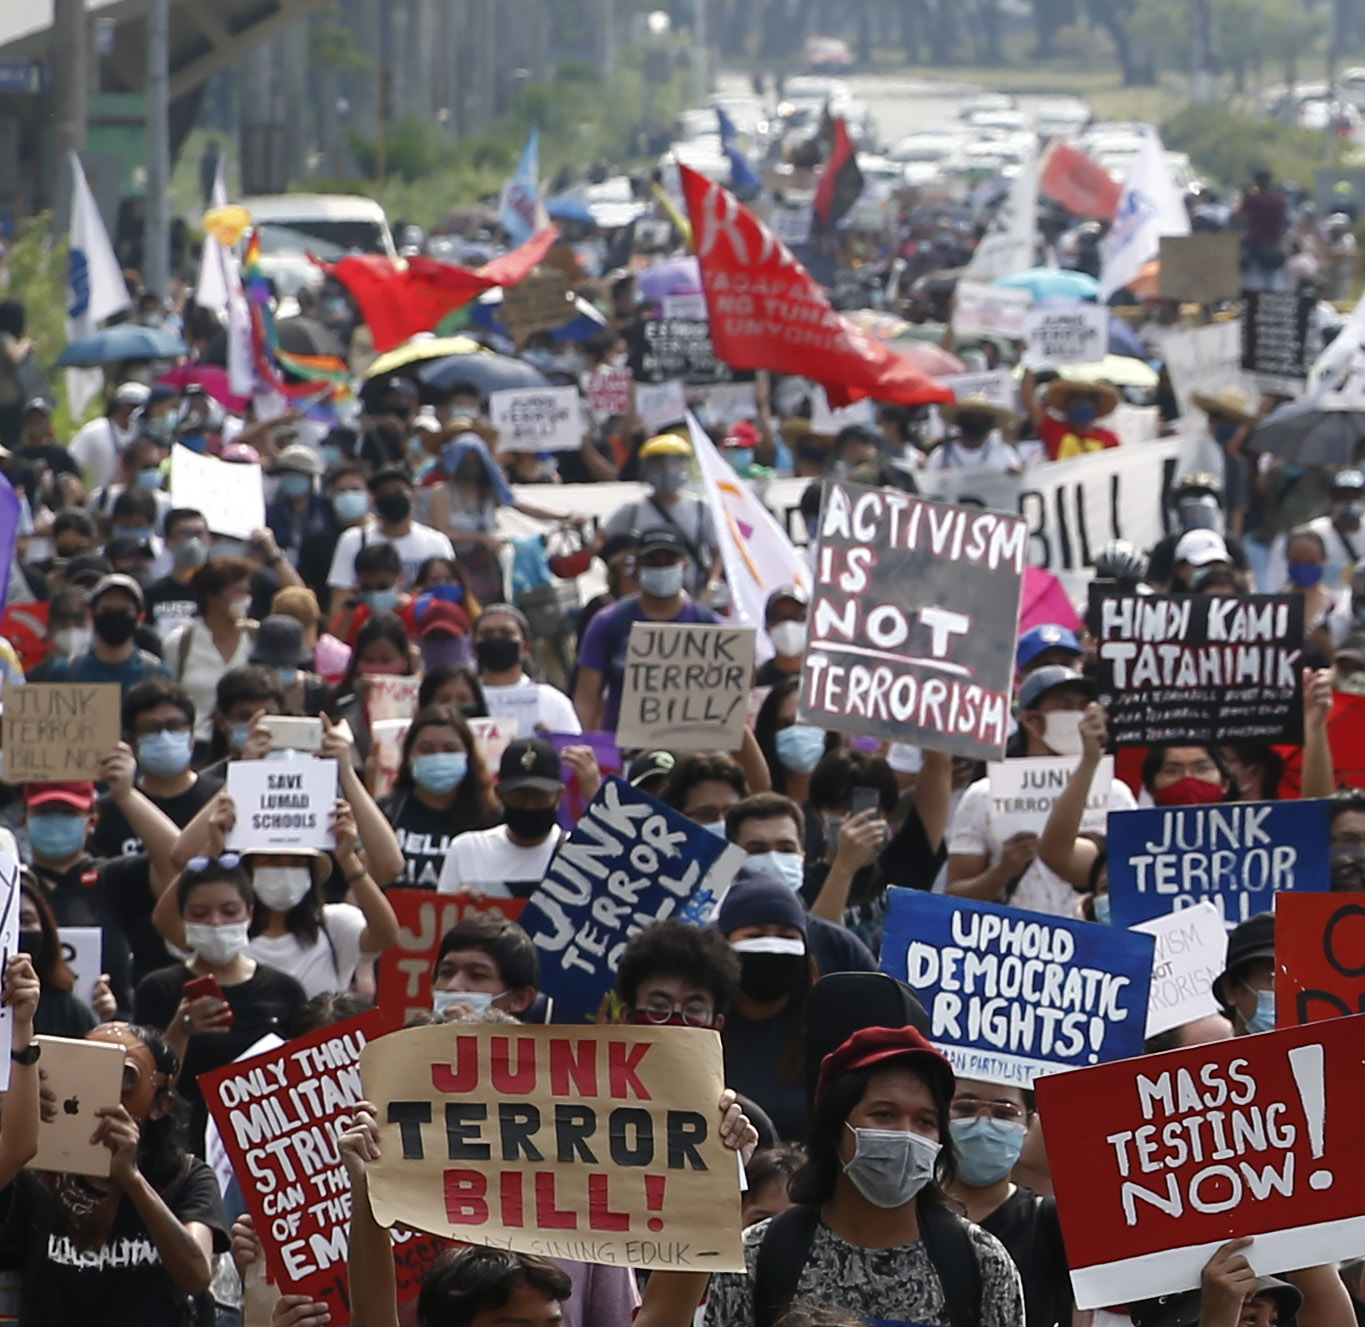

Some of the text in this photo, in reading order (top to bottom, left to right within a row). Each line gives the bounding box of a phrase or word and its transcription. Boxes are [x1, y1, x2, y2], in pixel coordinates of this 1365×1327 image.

[822, 483, 1027, 575] ACTIVISM
[818, 546, 873, 594] IS
[814, 599, 970, 657] NOT
[1101, 597, 1192, 642] HINDI
[1207, 597, 1290, 643] KAMI
[630, 629, 738, 661] JUNK
[1100, 641, 1303, 689] TATAHIMIK
[628, 662, 744, 692] TERROR
[805, 653, 1005, 746] TERRORISM
[639, 695, 742, 725] BILL!
[259, 793, 310, 810] LUMAD
[266, 773, 304, 790] SAVE
[1020, 769, 1068, 790] JUN
[251, 812, 318, 830] SCHOOLS
[994, 796, 1052, 815] TERRO
[1144, 805, 1273, 854] JUNK
[529, 780, 653, 952] JUNK
[1128, 845, 1298, 895] TERROR
[561, 814, 688, 976] TERROR
[951, 909, 1075, 965] UPHOLD
[906, 940, 1131, 1023] DEMOCRATIC
[931, 991, 1107, 1065] RIGHTS!
[218, 1029, 369, 1108] ONLY THRU
[430, 1034, 653, 1101] JUNK
[969, 1055, 1036, 1083] PARTYLIST
[1135, 1057, 1257, 1121] MASS
[229, 1063, 364, 1152] MILITAN
[245, 1115, 350, 1194] STRU
[386, 1100, 710, 1172] TERROR
[1106, 1102, 1297, 1177] TESTING
[262, 1182, 305, 1217] CAN
[442, 1168, 668, 1234] BILL!
[271, 1210, 303, 1242] OF
